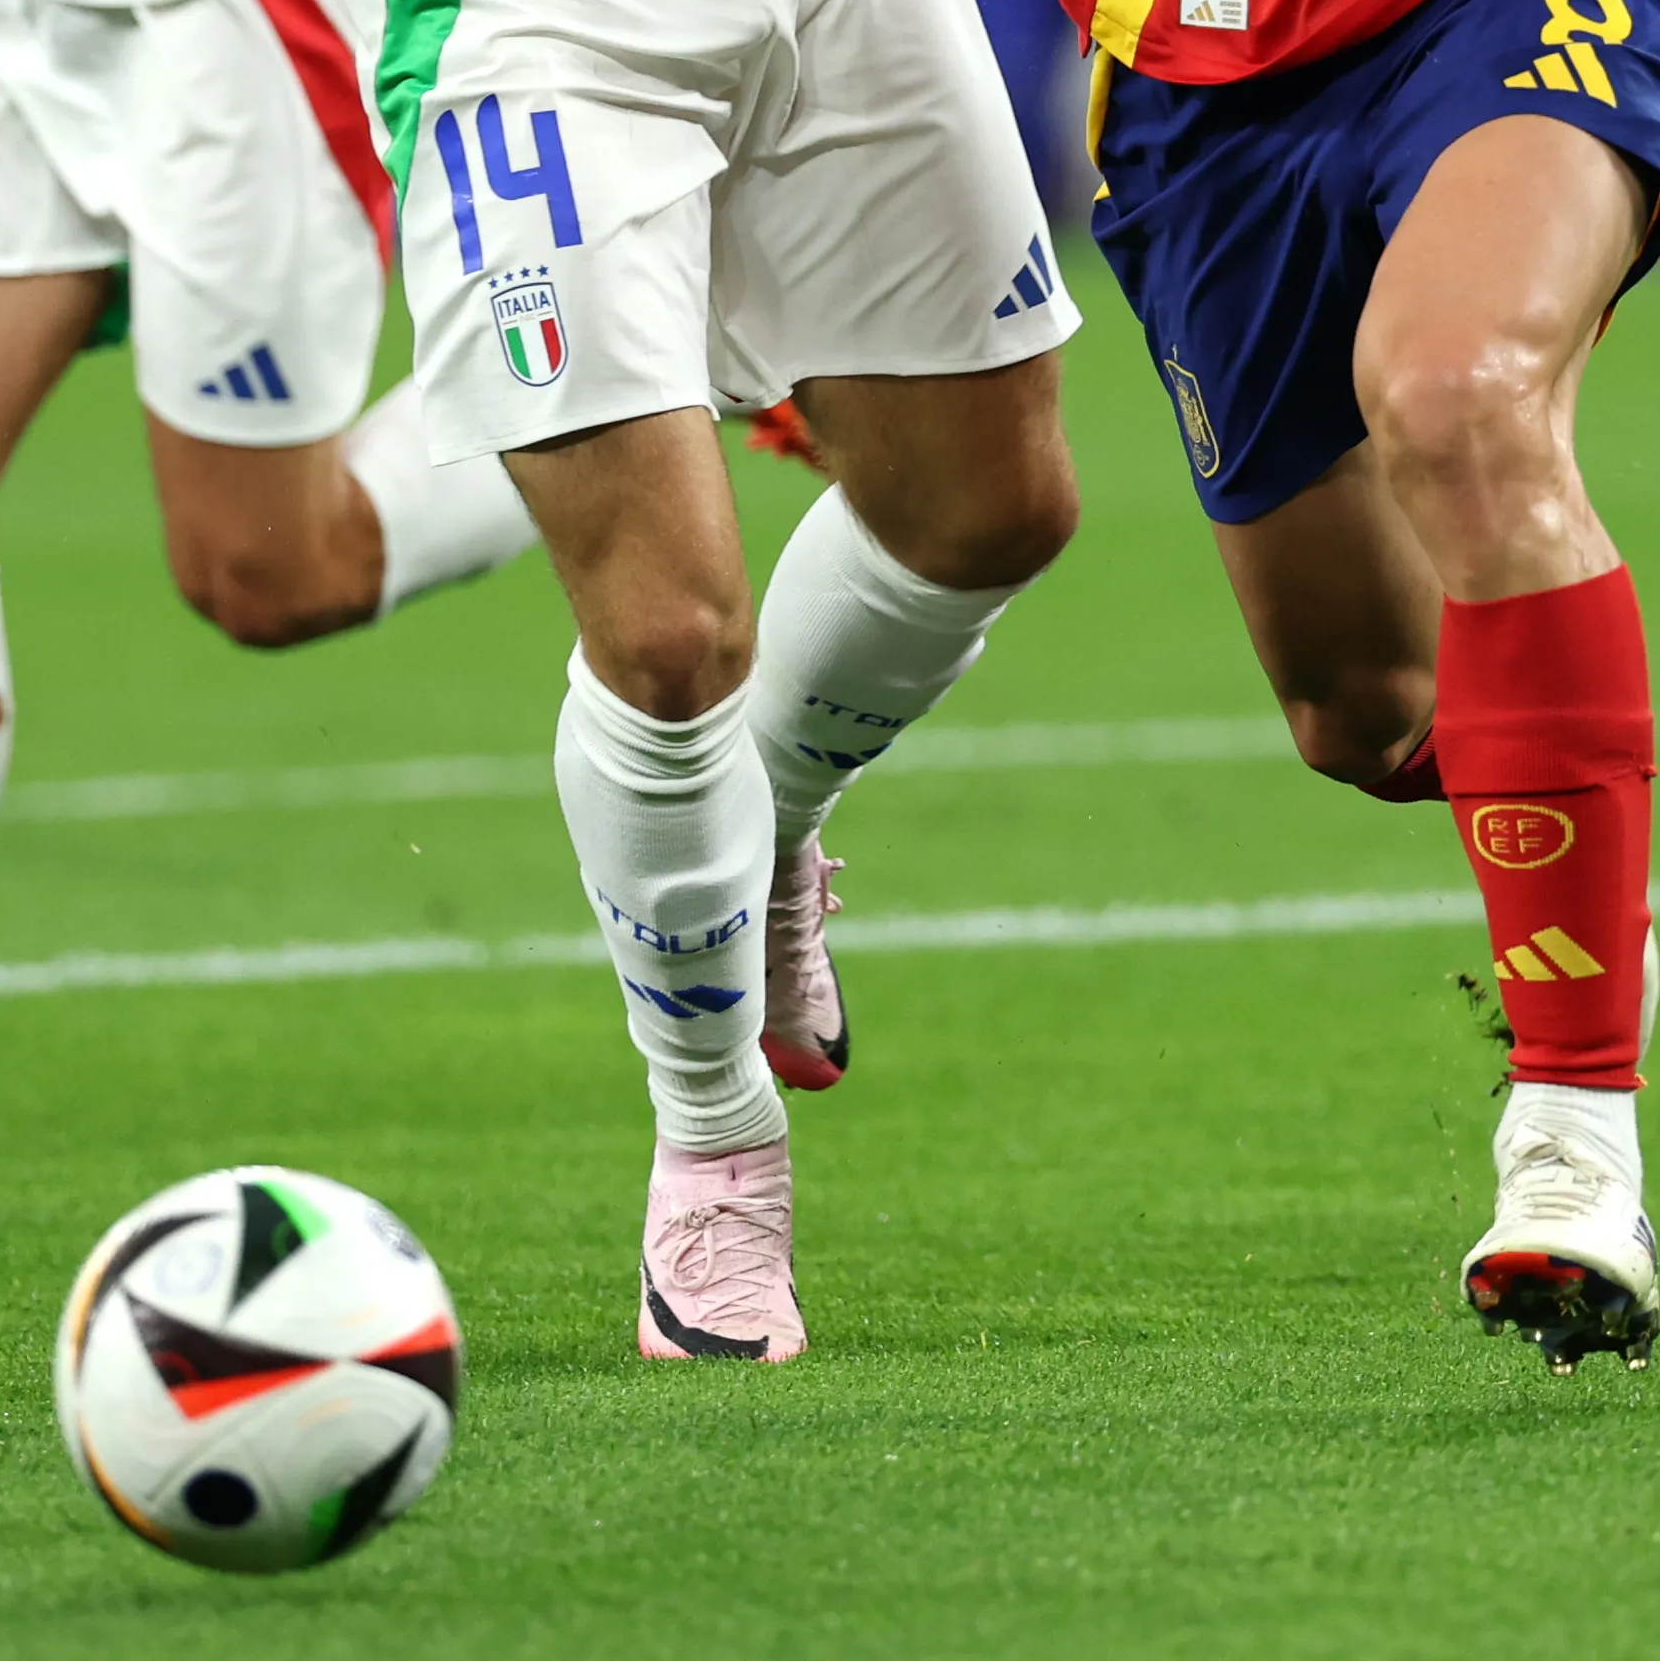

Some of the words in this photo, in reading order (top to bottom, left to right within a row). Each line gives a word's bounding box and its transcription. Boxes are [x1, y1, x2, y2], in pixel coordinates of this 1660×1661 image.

[434, 93, 584, 276] 14
[497, 290, 552, 319] ITALIA
[595, 886, 751, 955] ITALIA
